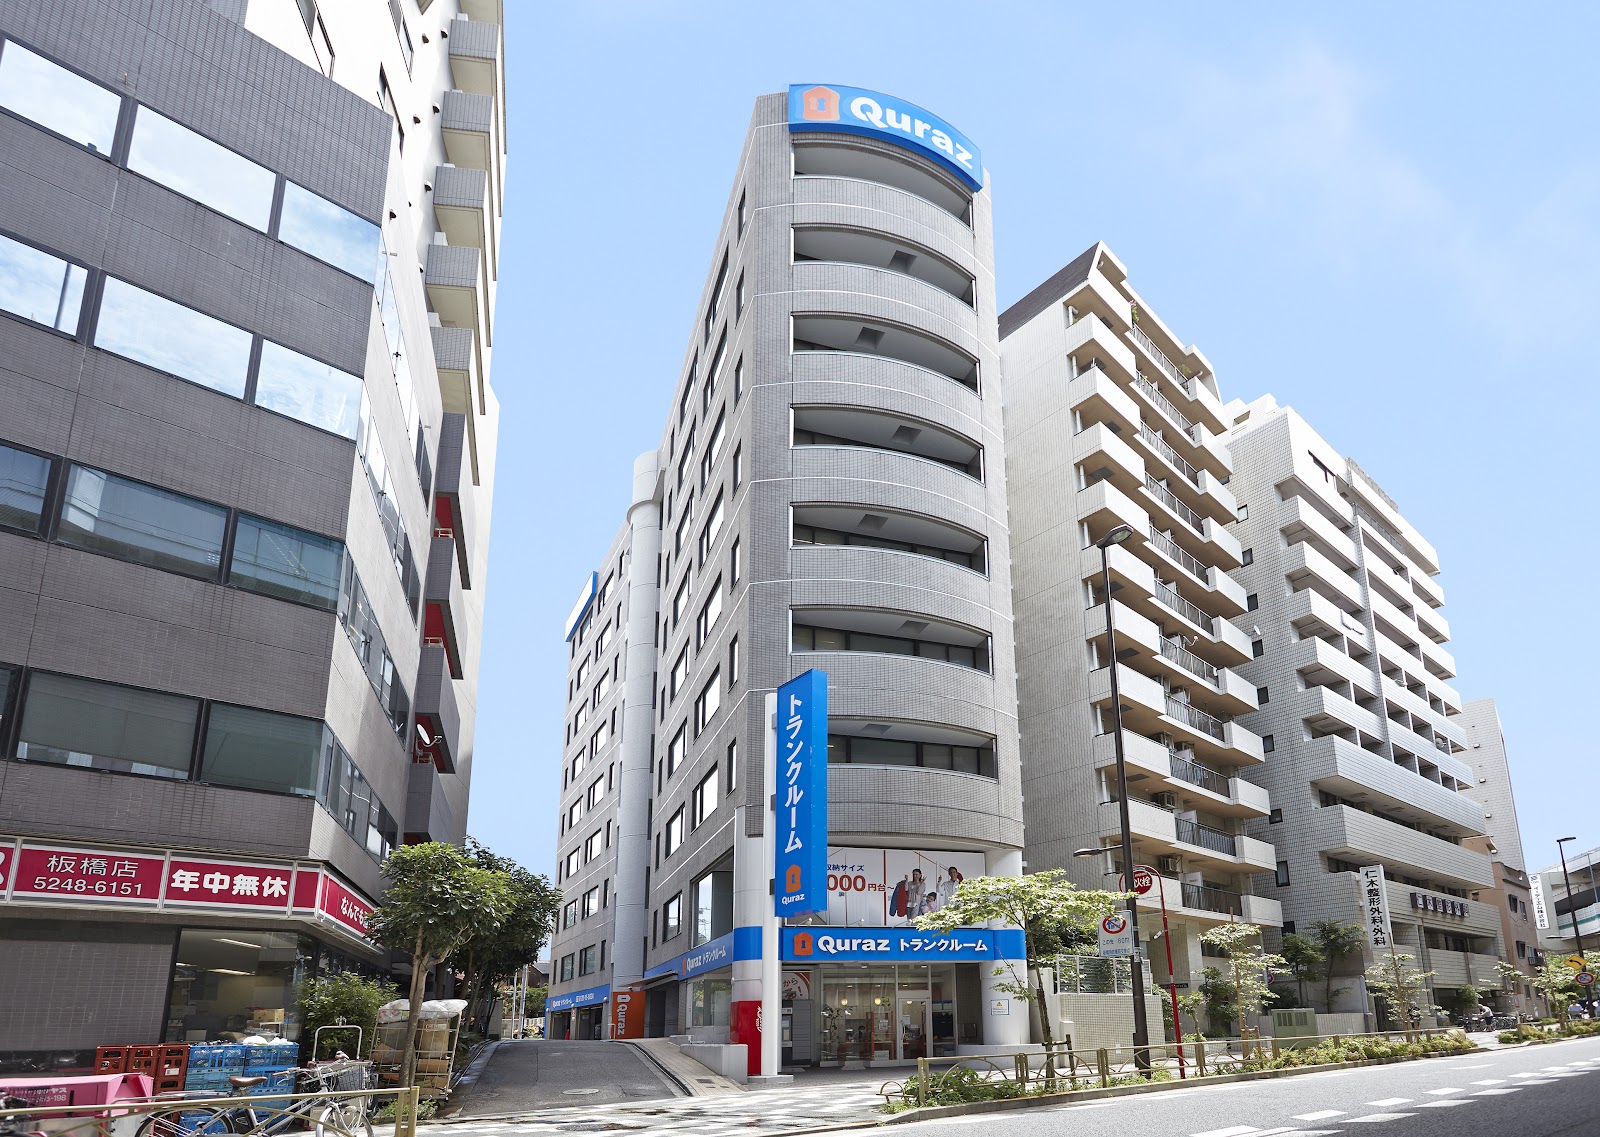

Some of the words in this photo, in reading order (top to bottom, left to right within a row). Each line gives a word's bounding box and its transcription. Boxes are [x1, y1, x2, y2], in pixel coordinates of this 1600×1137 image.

[850, 96, 973, 170] Quraz
[784, 693, 804, 854] トランクルーム
[46, 854, 140, 878] 板橋店
[33, 876, 143, 896] 5248-6151
[170, 869, 289, 898] 年中無休
[1133, 876, 1151, 888] 火栓
[781, 892, 806, 905] Quraz
[817, 935, 891, 955] Quraz
[899, 938, 988, 952] トランクルーム
[686, 955, 702, 972] Quraz
[617, 1004, 629, 1035] Quraz
